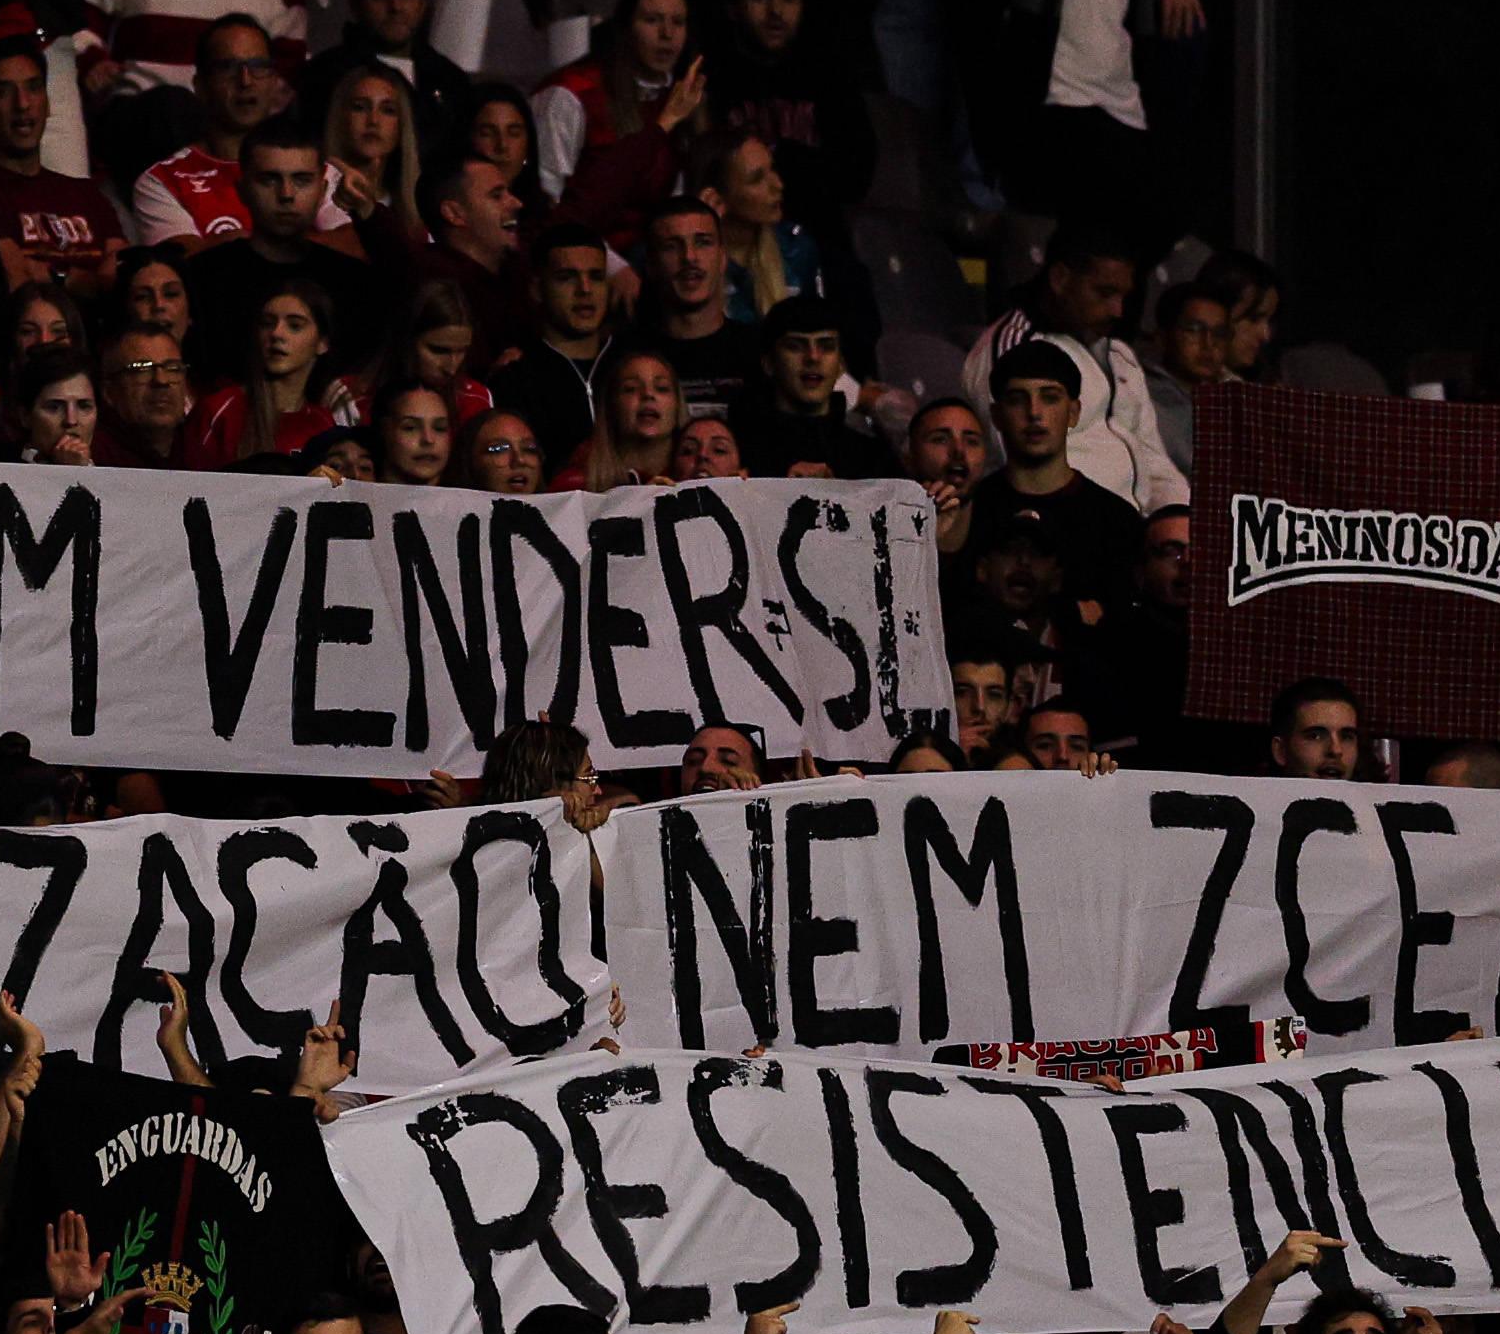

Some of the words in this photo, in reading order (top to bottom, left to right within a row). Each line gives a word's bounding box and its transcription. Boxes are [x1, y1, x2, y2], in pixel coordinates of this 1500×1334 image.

[1236, 499, 1451, 578] MENINOS
[659, 795, 1034, 1048] NEM
[93, 1112, 273, 1214] ENGUARDAS
